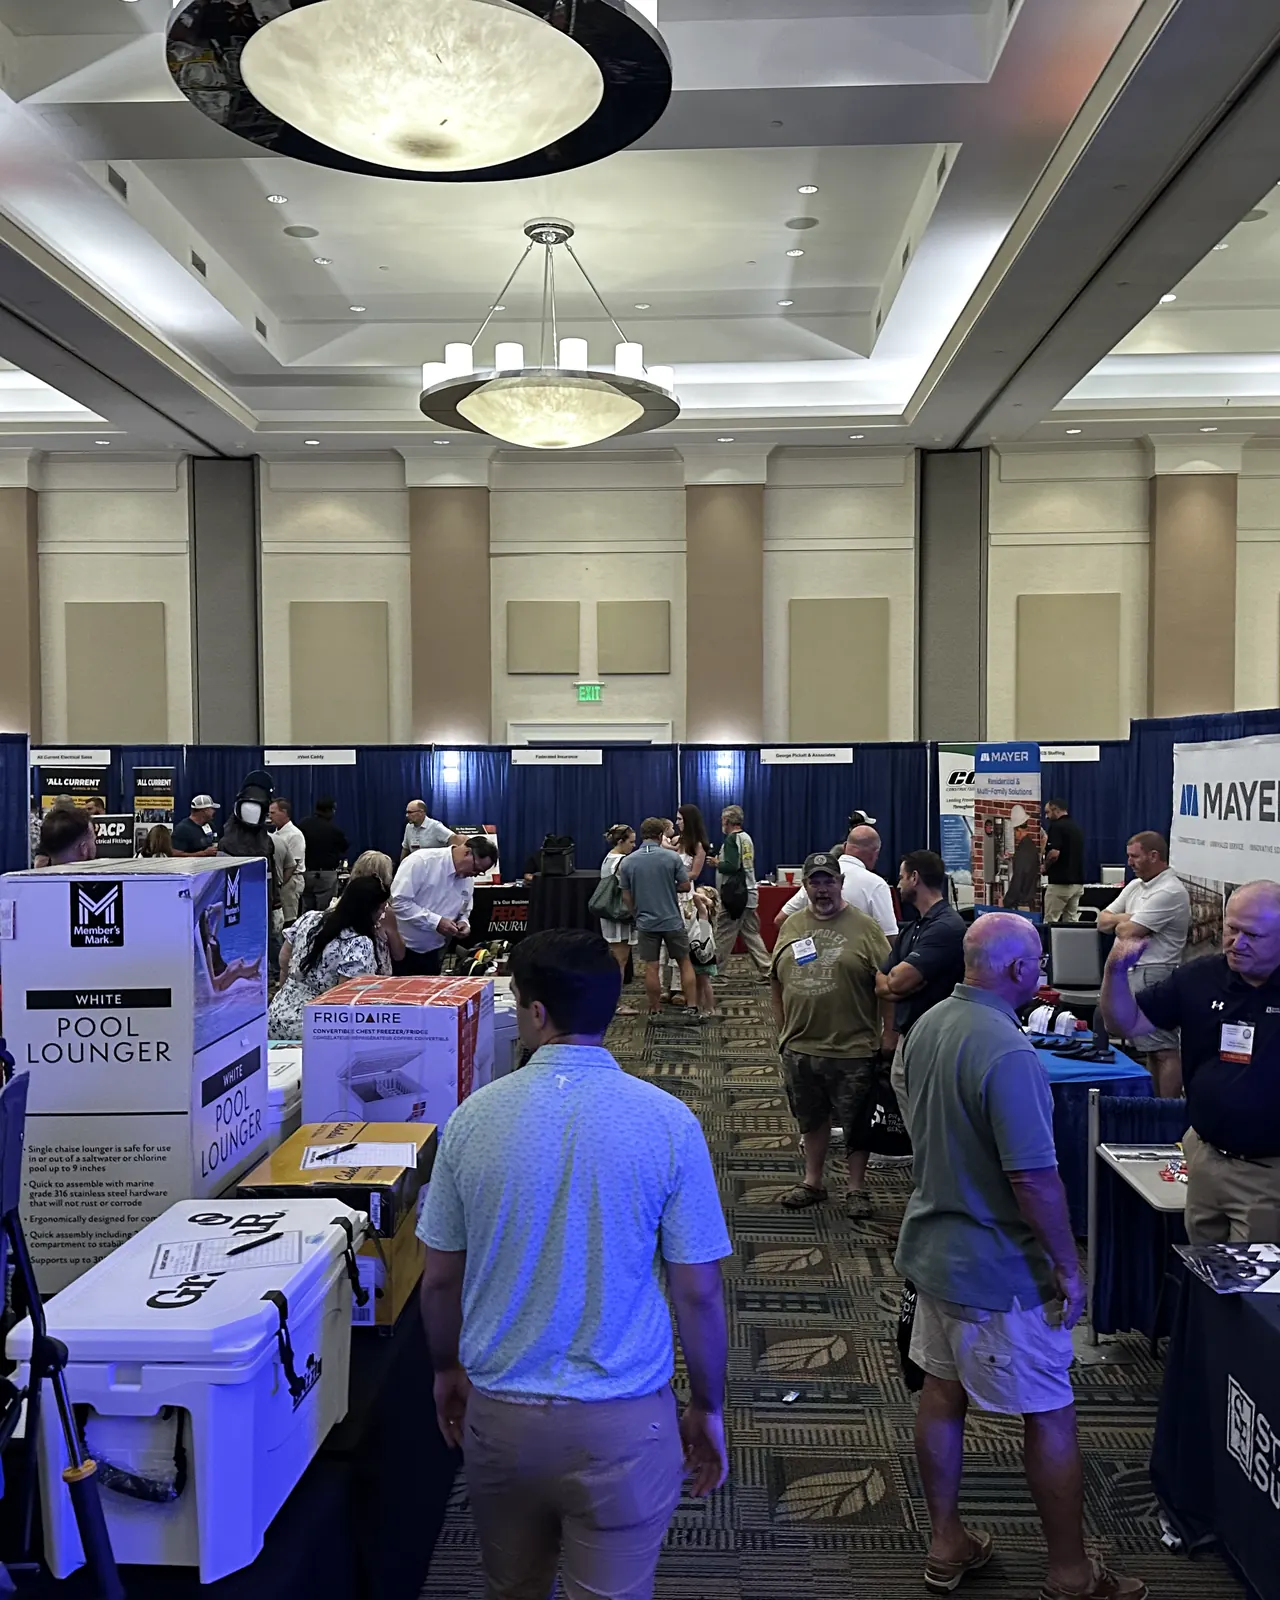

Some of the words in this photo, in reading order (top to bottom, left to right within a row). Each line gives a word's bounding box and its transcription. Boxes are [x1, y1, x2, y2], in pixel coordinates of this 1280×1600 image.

[580, 686, 600, 701] EXIT
[992, 752, 1028, 762] MAYER
[1204, 780, 1280, 822] MAYE
[491, 906, 528, 920] FEDE
[74, 926, 120, 935] Member's
[85, 936, 109, 944] Mark
[75, 994, 122, 1005] WHITE
[314, 1012, 401, 1023] FRIGIDAIRE
[58, 1016, 139, 1038] POOL
[28, 1042, 172, 1064] LOUNGER
[223, 1064, 243, 1086] WHITE
[216, 1086, 250, 1132] POOL
[201, 1109, 262, 1178] LOUNGER
[28, 1146, 50, 1156] Single
[82, 1145, 112, 1154] lounger
[124, 1144, 140, 1152] safe
[142, 1144, 154, 1152] for
[82, 1154, 120, 1162] saltwater
[29, 1165, 47, 1174] pool
[29, 1190, 52, 1199] grade
[30, 1215, 86, 1224] Ergonomically
[88, 1215, 125, 1224] designed
[30, 1231, 53, 1239] Quick
[55, 1231, 92, 1239] assembly
[95, 1230, 132, 1239] including
[30, 1241, 86, 1250] compartment
[30, 1256, 67, 1265] Supports
